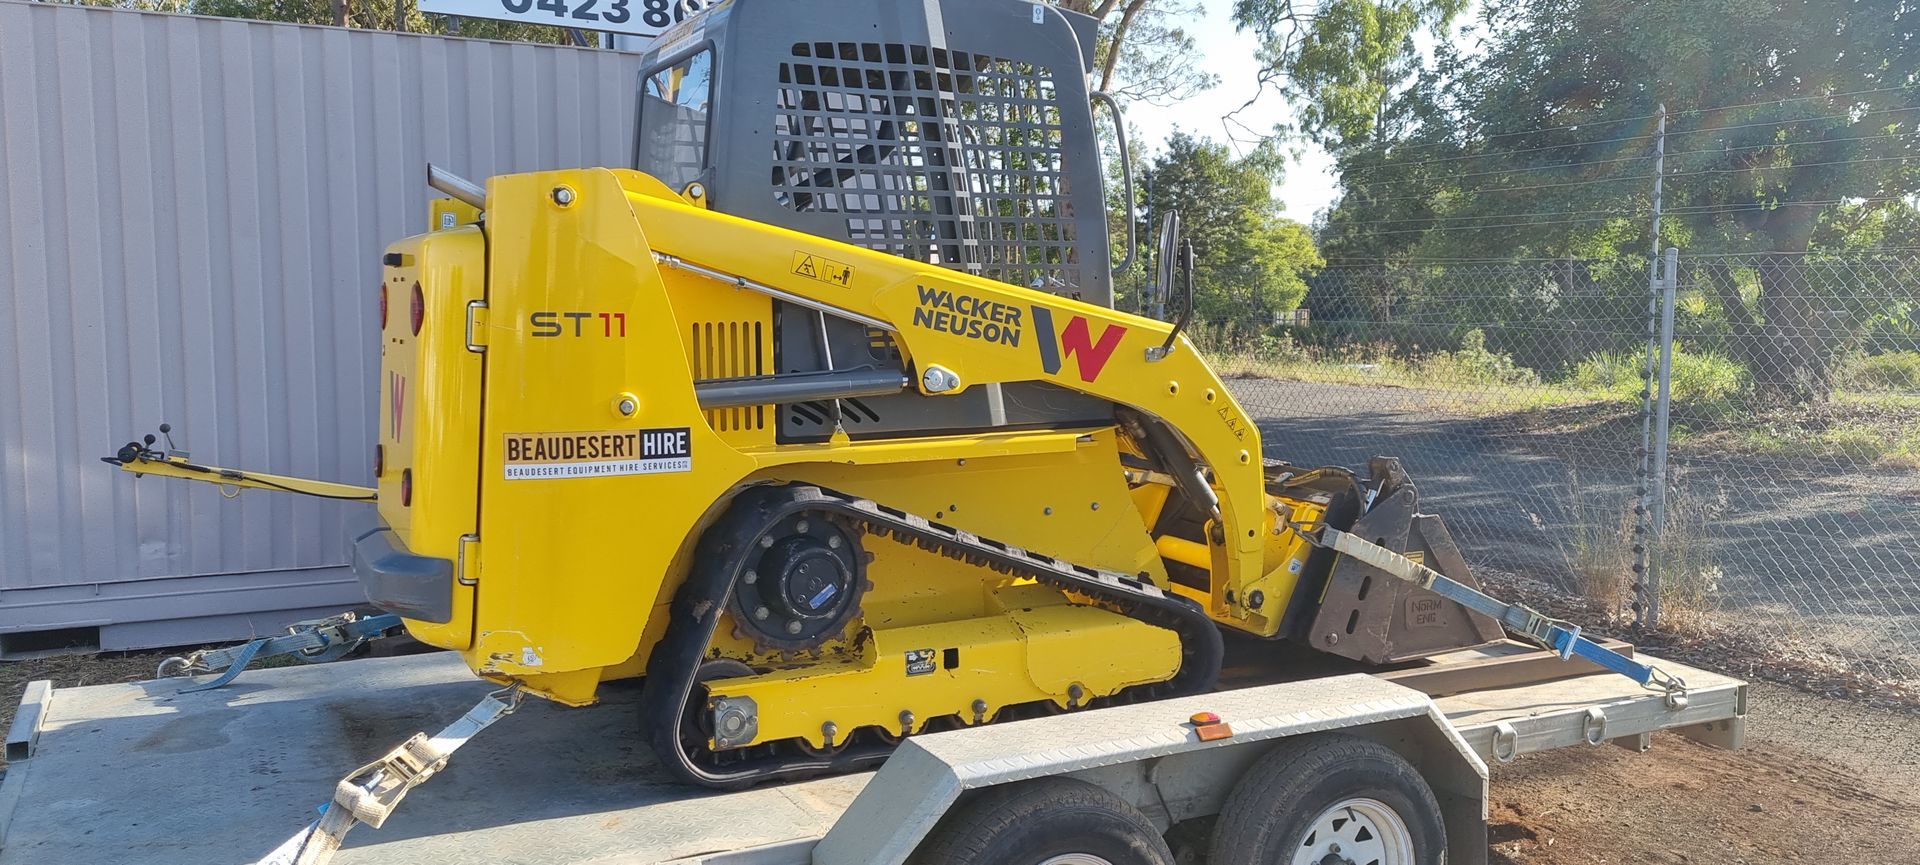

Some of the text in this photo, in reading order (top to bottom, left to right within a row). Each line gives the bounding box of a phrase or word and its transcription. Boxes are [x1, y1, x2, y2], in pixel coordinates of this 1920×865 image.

[917, 285, 1022, 327] WACKER
[530, 312, 625, 337] ST 11
[913, 307, 1021, 348] NEUSON
[508, 432, 687, 461] BEAUDESERT HIRE
[507, 467, 564, 476] BEAUDESERT
[567, 464, 617, 474] EQUIPMENT
[619, 463, 639, 472] HIRE
[642, 461, 682, 471] SERVICES
